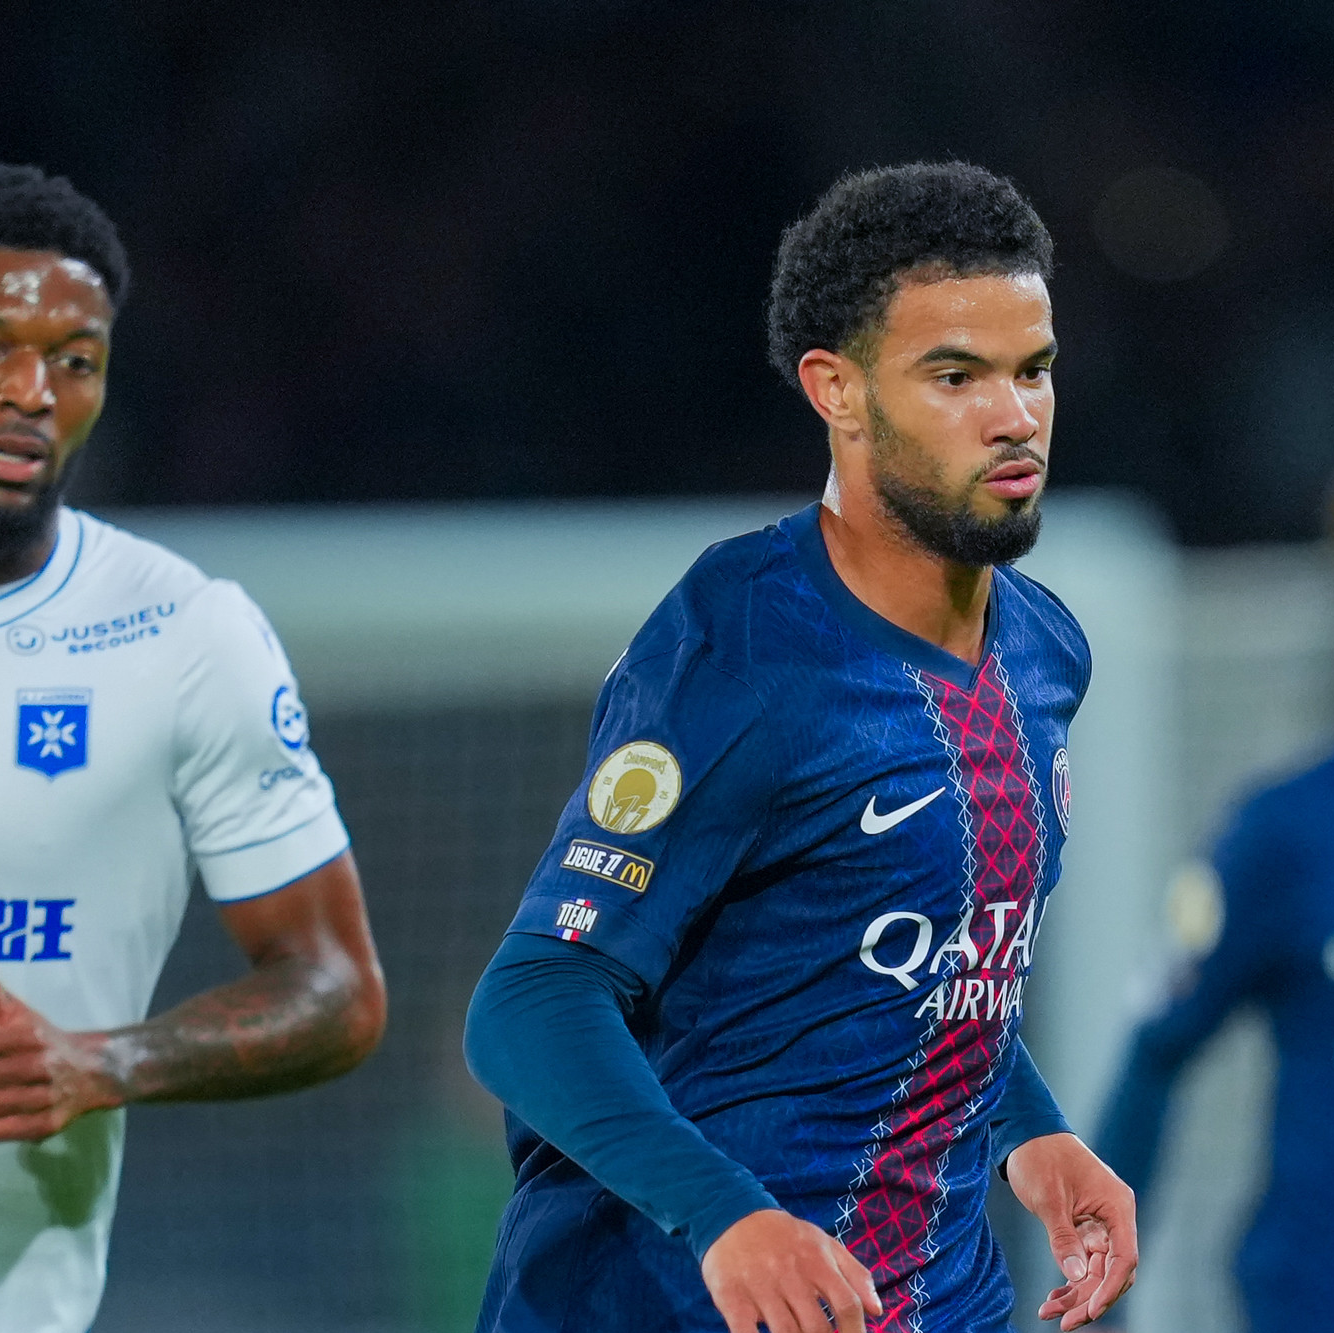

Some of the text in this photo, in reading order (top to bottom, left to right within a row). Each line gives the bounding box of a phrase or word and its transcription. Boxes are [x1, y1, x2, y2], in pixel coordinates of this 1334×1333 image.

[51, 602, 176, 642] JUSSIEU
[68, 625, 160, 655] secours
[563, 845, 607, 873] LIGUE
[859, 895, 1050, 992] QATA
[913, 976, 1030, 1022] AIRWA
